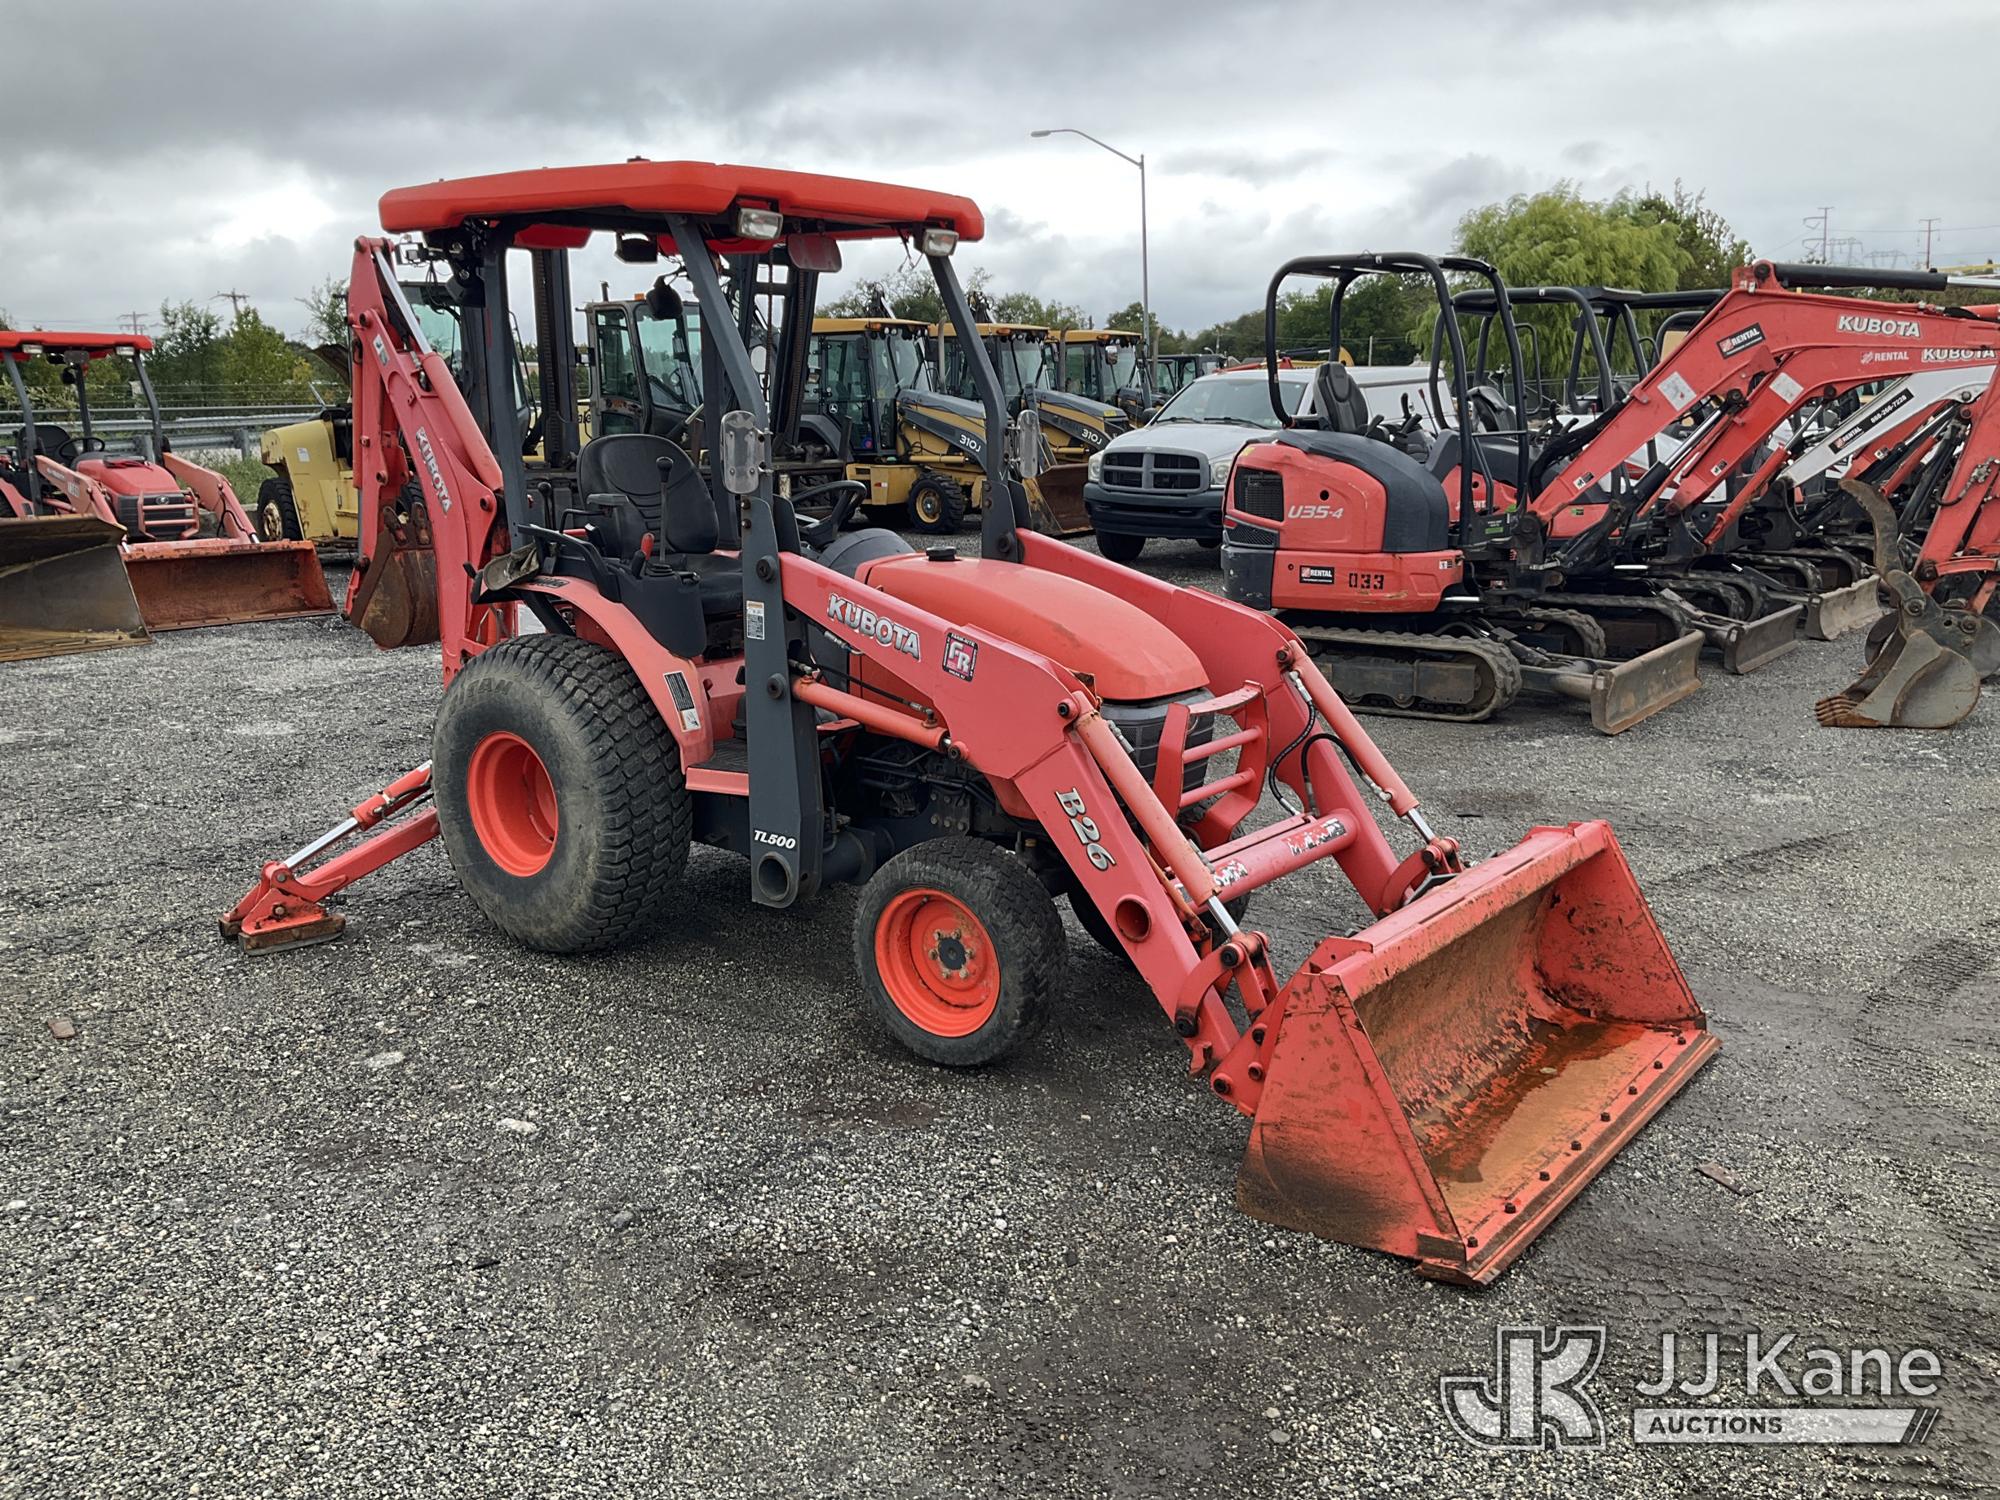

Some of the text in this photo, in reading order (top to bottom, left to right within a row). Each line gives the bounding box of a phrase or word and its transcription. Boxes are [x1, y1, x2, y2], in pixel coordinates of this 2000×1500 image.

[1837, 315, 1921, 338] KUBOTA
[1731, 328, 1760, 346] RENTAL
[1874, 351, 1909, 362] RENTAL
[959, 434, 982, 453] 310J
[1081, 428, 1103, 446] 310J
[1842, 426, 1863, 443] RENTAL
[415, 426, 452, 516] KUBOTA
[1287, 504, 1344, 519] U35-4
[1310, 569, 1333, 578] RENTAL
[1349, 573, 1385, 590] 033
[827, 593, 921, 662] KUBOTA
[1054, 786, 1117, 871] B26
[753, 829, 796, 850] TL500
